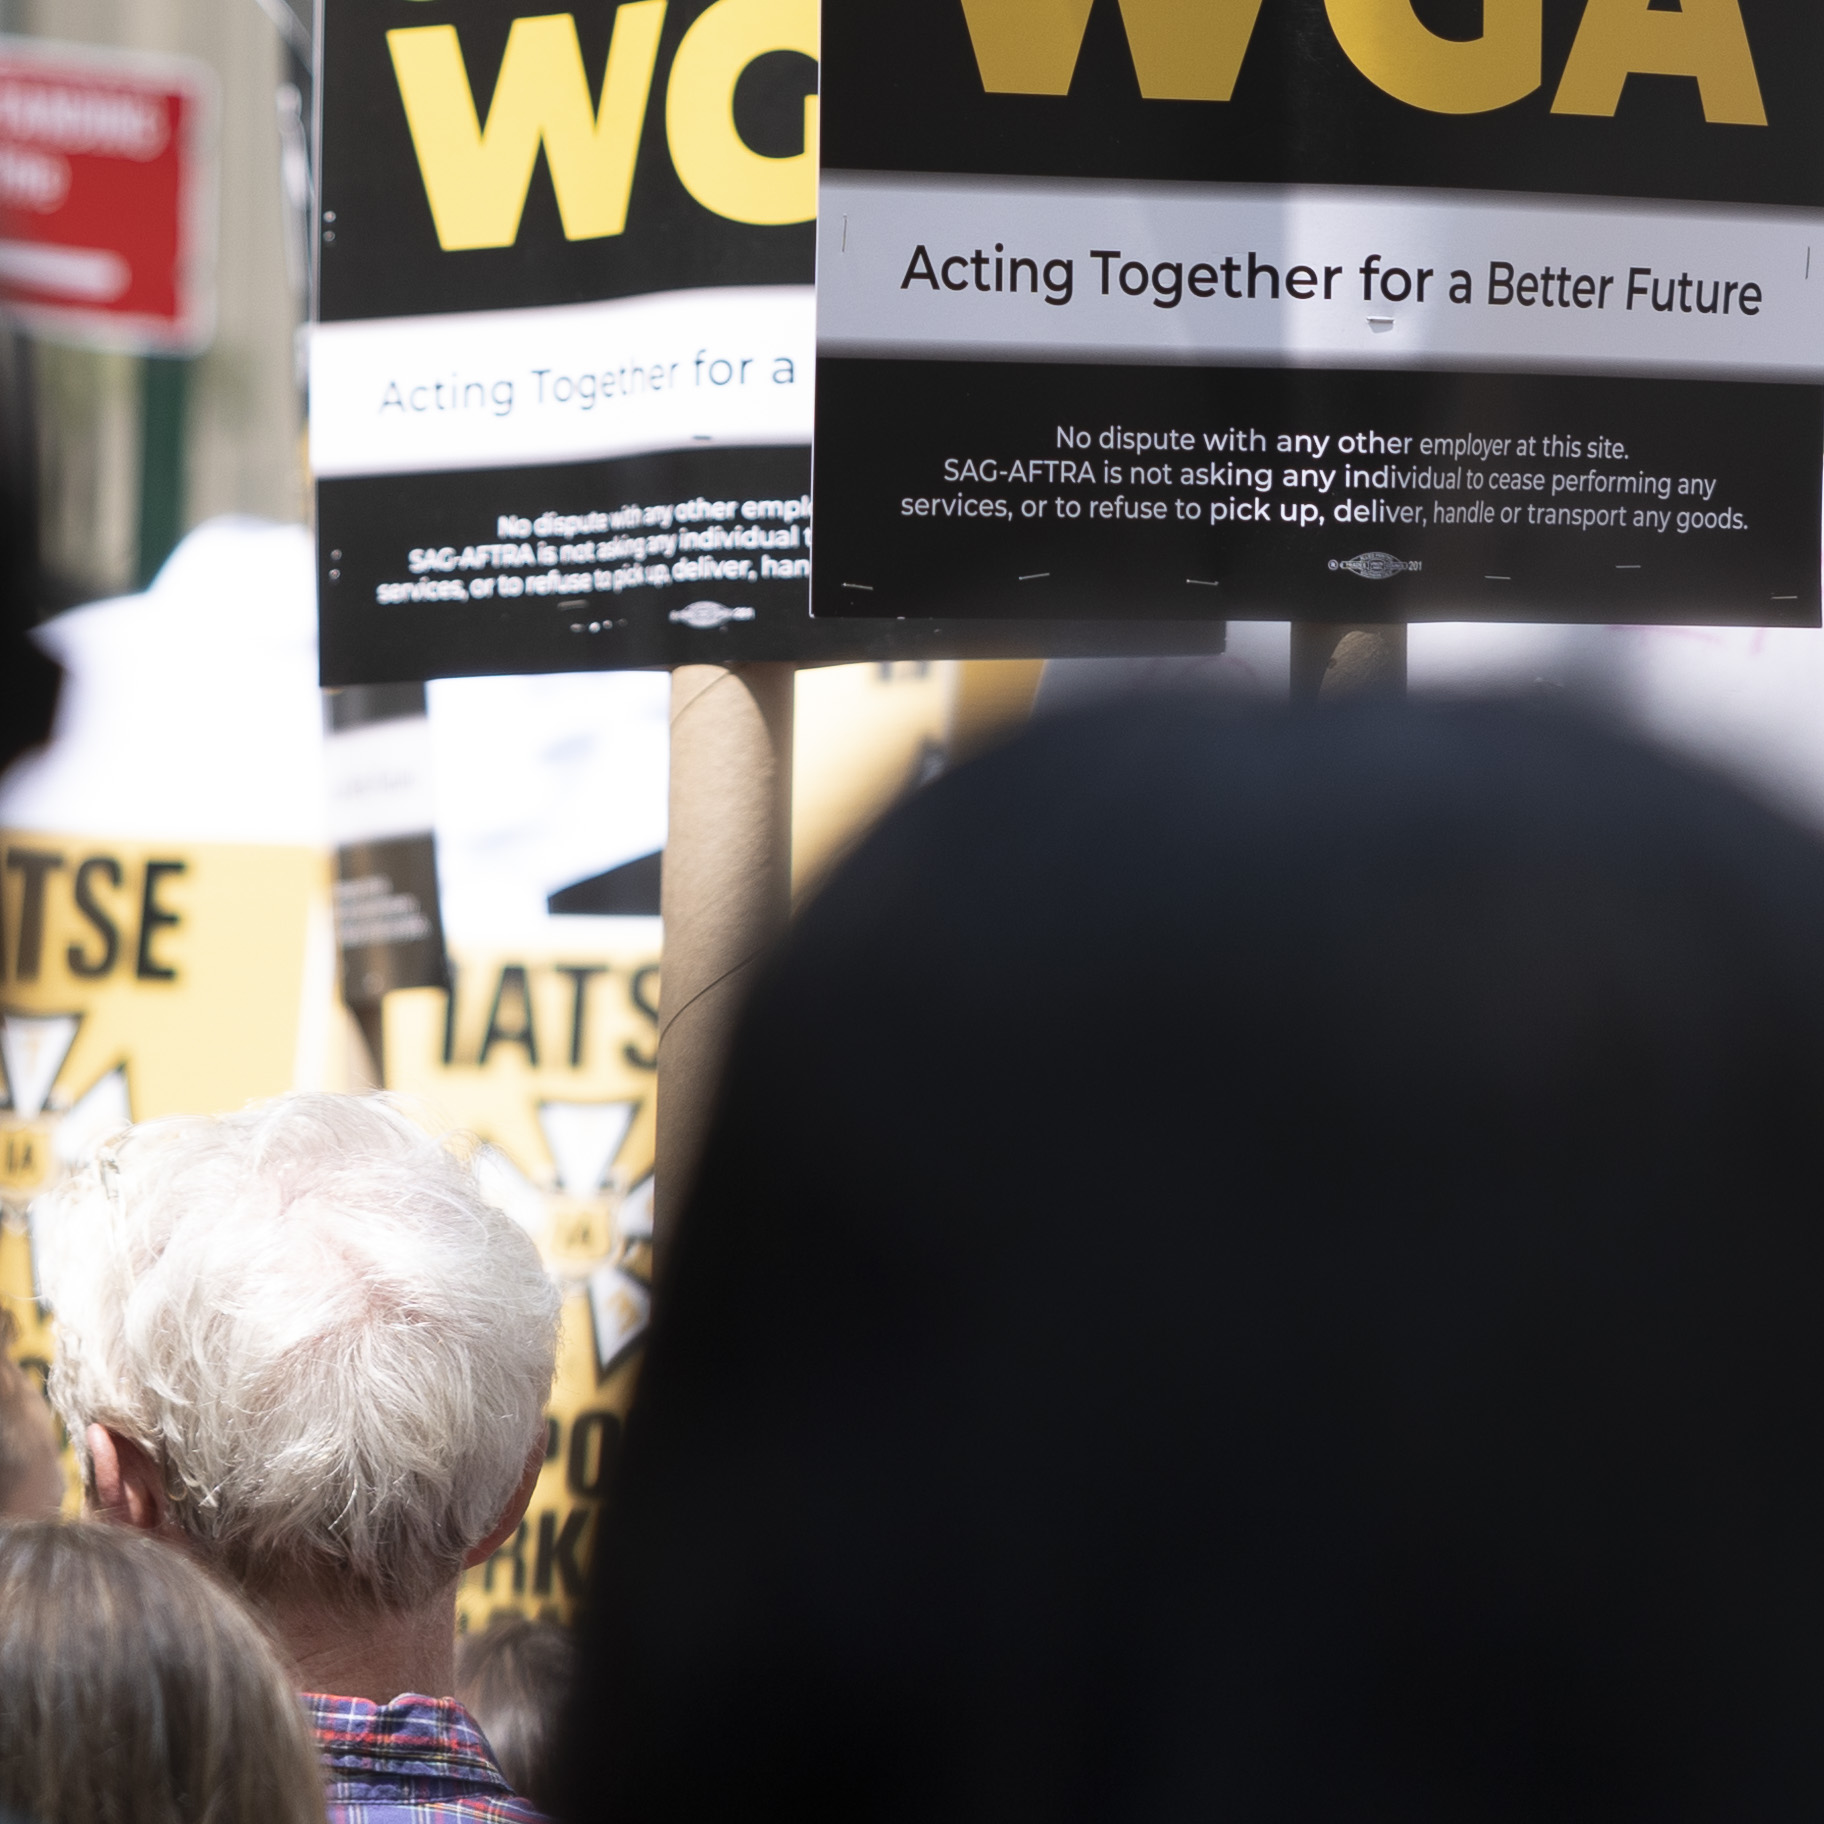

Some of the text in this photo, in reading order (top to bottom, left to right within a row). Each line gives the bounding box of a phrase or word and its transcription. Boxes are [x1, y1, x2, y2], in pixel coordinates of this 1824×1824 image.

[900, 243, 1763, 316] Acting Together for a Better Future
[379, 348, 796, 417] Acting Together for a
[1056, 425, 1629, 460] No dispute with any other employer at this site.
[943, 459, 1717, 501] SAG-AFTRA is not asking any individual to cease performing any
[496, 514, 533, 539] No
[533, 511, 609, 541] dispute
[674, 496, 739, 523] other
[900, 493, 1749, 532] services, or to refuse to pick up, deliver, handle or transport any goods.
[408, 542, 537, 575] SAG-AFTRA
[536, 540, 559, 567] is
[559, 540, 596, 565] not
[678, 524, 800, 552] individual
[376, 576, 470, 605] services,
[469, 577, 496, 600] or
[496, 574, 525, 598] to
[524, 568, 594, 596] refuse
[671, 554, 758, 584] deliver,
